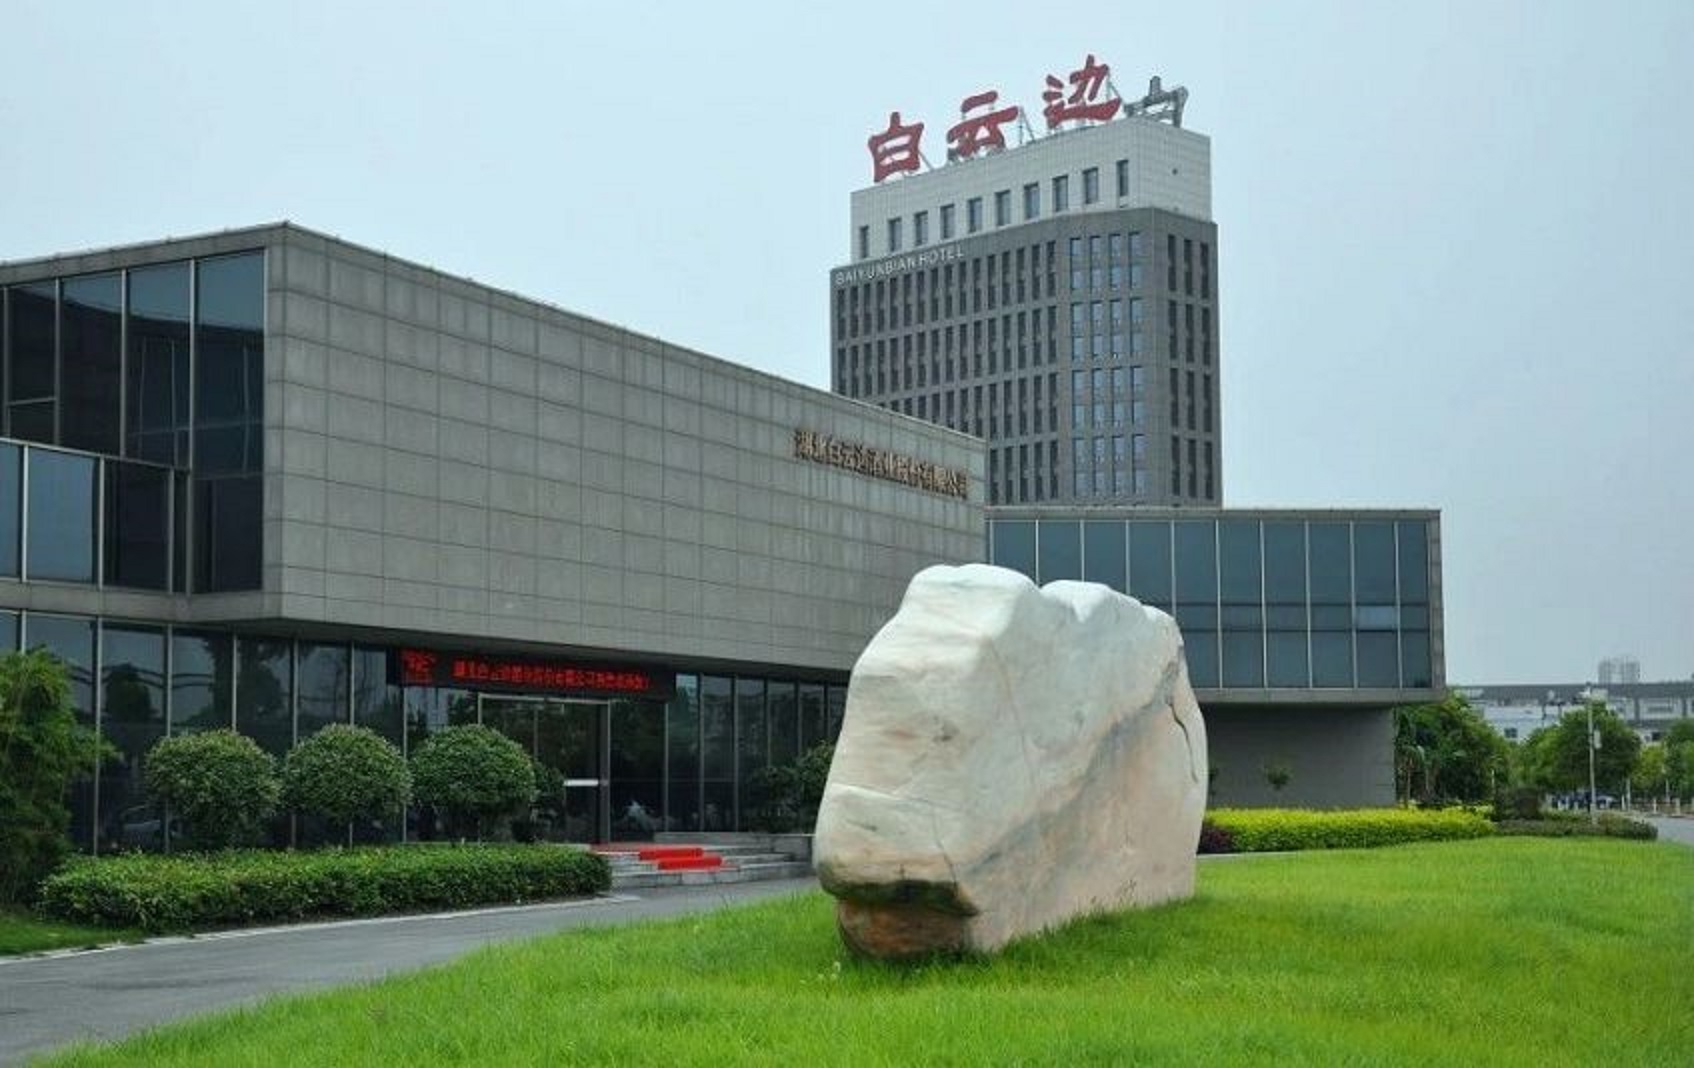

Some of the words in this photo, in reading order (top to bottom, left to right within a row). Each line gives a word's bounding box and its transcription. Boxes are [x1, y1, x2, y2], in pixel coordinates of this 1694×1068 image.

[868, 54, 1122, 182] 白云边
[919, 243, 964, 265] HOTEL
